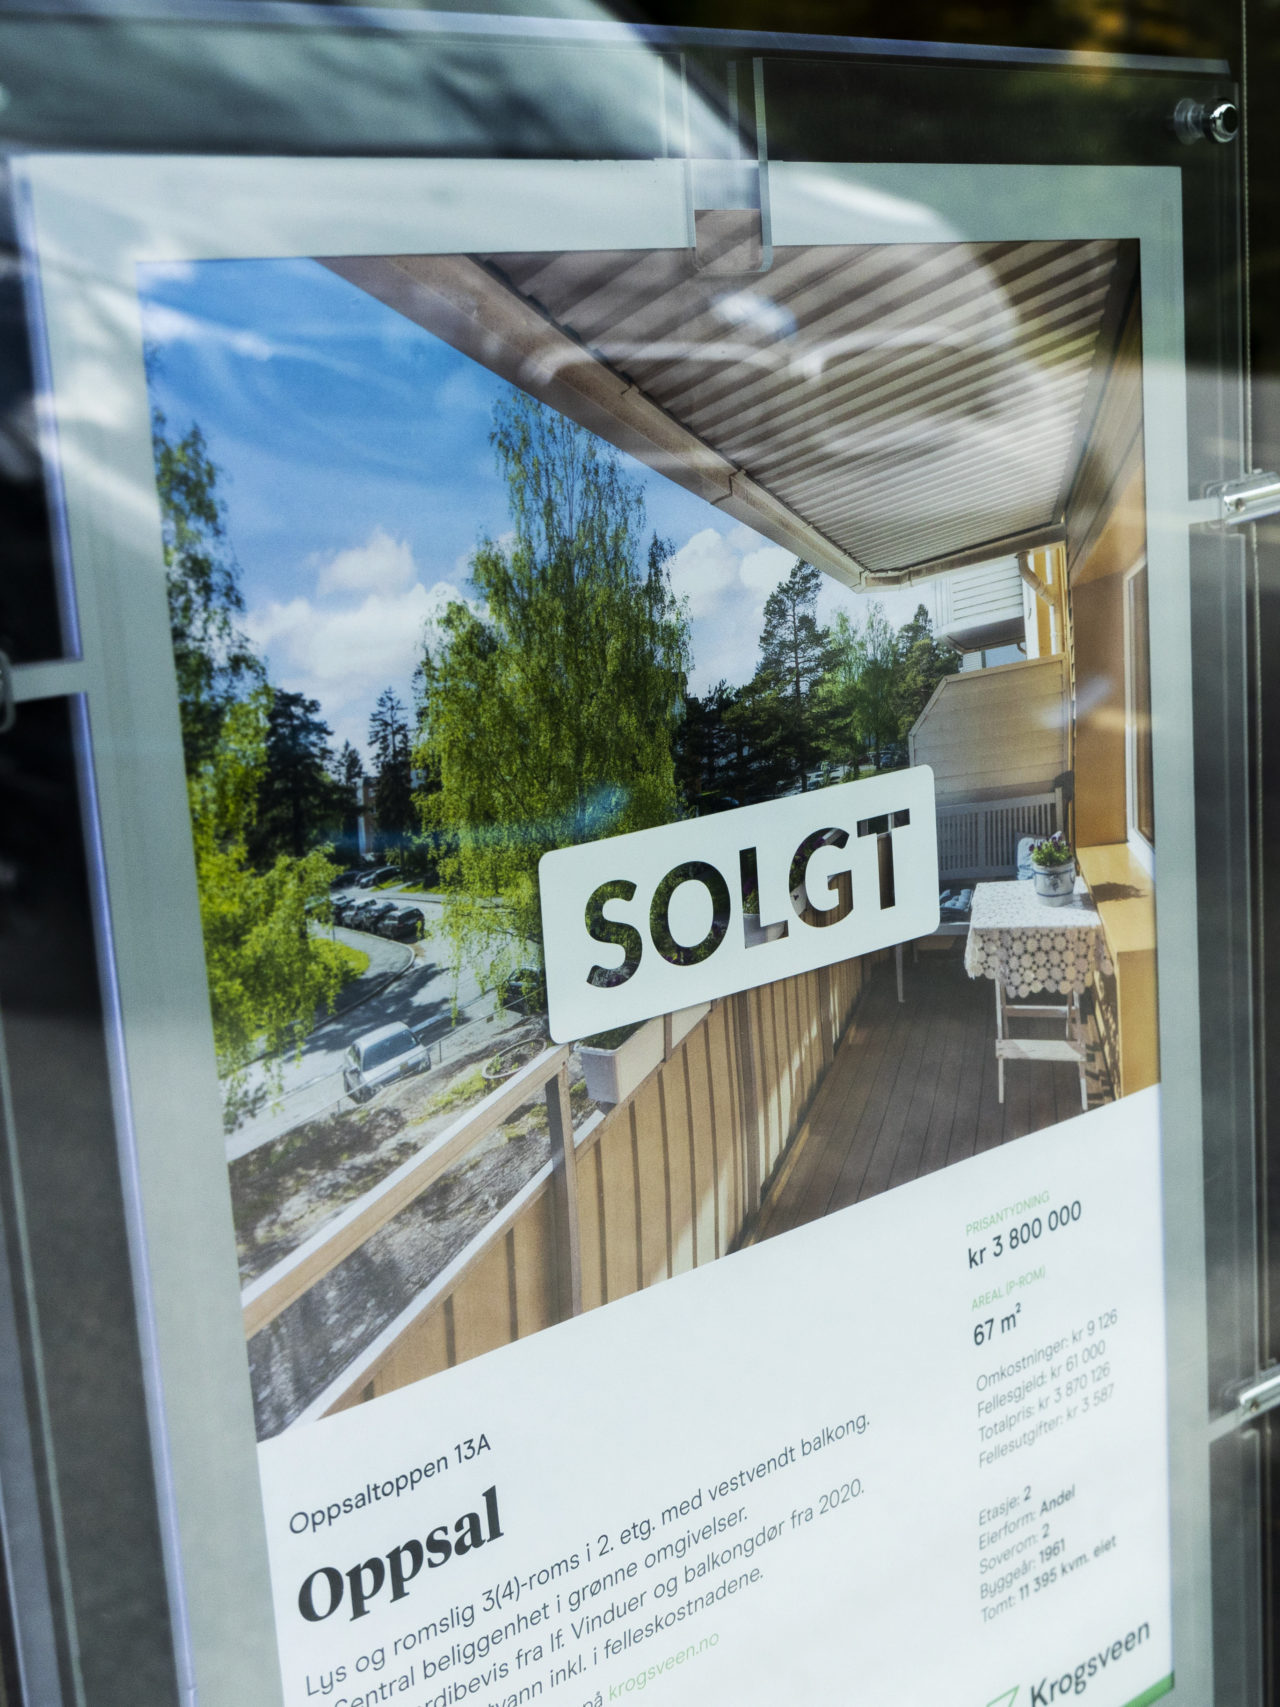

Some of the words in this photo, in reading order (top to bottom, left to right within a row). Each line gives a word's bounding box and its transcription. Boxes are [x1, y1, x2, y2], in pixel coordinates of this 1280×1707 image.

[584, 808, 911, 988] SOLGT
[966, 1190, 1050, 1236] PRISANTYDNING
[968, 1247, 986, 1269] kr
[992, 1234, 1003, 1257] 3
[1009, 1217, 1042, 1249] 800
[1048, 1200, 1082, 1231] 000
[971, 1287, 1004, 1312] AREAL
[1006, 1265, 1046, 1295] (P-ROM)
[973, 1317, 994, 1346] 67
[976, 1337, 1069, 1392] Omkostninger:
[1071, 1327, 1083, 1344] kr
[1087, 1320, 1095, 1336] 9
[1098, 1308, 1118, 1330] 126
[977, 1371, 1047, 1418] Fellesgjeld:
[1050, 1363, 1062, 1380] kr
[1066, 1353, 1078, 1373] 61
[1081, 1339, 1106, 1364] 000
[978, 1404, 1035, 1442] Totalpris:
[1038, 1395, 1050, 1412] kr
[1054, 1387, 1062, 1404] 3
[1065, 1374, 1088, 1398] 870
[1091, 1361, 1111, 1384] 126
[979, 1414, 1064, 1468] Fellesutgifter:
[1066, 1405, 1079, 1422] kr
[1082, 1397, 1090, 1413] 3
[289, 1456, 449, 1534] Oppsaltoppen
[454, 1433, 492, 1464] 13A
[978, 1495, 1020, 1526] Etasje:
[1023, 1485, 1031, 1502] 2
[978, 1510, 1036, 1551] Eierform:
[1039, 1483, 1076, 1517] Andel
[298, 1485, 504, 1622] Oppsal
[305, 1665, 347, 1697] Lys
[355, 1647, 385, 1673] og
[393, 1604, 475, 1655] romslig
[482, 1553, 580, 1612] 3(4)-roms
[586, 1543, 591, 1562] i
[597, 1534, 614, 1556] 2.
[620, 1519, 656, 1546] etg.
[661, 1489, 703, 1526] med
[708, 1446, 796, 1501] vestvendt
[802, 1414, 870, 1456] balkong.
[515, 1645, 543, 1669] fra
[570, 1590, 647, 1639] Vinduer
[653, 1577, 678, 1600] og
[685, 1521, 785, 1584] balkongdør
[790, 1507, 814, 1530] fra
[819, 1478, 865, 1515] 2020.
[979, 1533, 1038, 1575] Soverom:
[1041, 1523, 1050, 1539] 2
[980, 1595, 1016, 1623] Tomt:
[1019, 1583, 1030, 1600] 11
[1033, 1566, 1058, 1592] 395
[1093, 1535, 1117, 1557] eiet
[1039, 1537, 1066, 1564] 1961
[423, 1602, 551, 1680] beliggenhet
[555, 1595, 561, 1613] i
[568, 1561, 638, 1612] grønne
[644, 1506, 748, 1568] omgivelser.
[550, 1655, 587, 1688] inkl.
[593, 1647, 598, 1665] i
[604, 1566, 764, 1659] felleskostnadene.
[608, 1632, 720, 1701] krogsveen.no
[1030, 1621, 1151, 1707] Krogsveen
